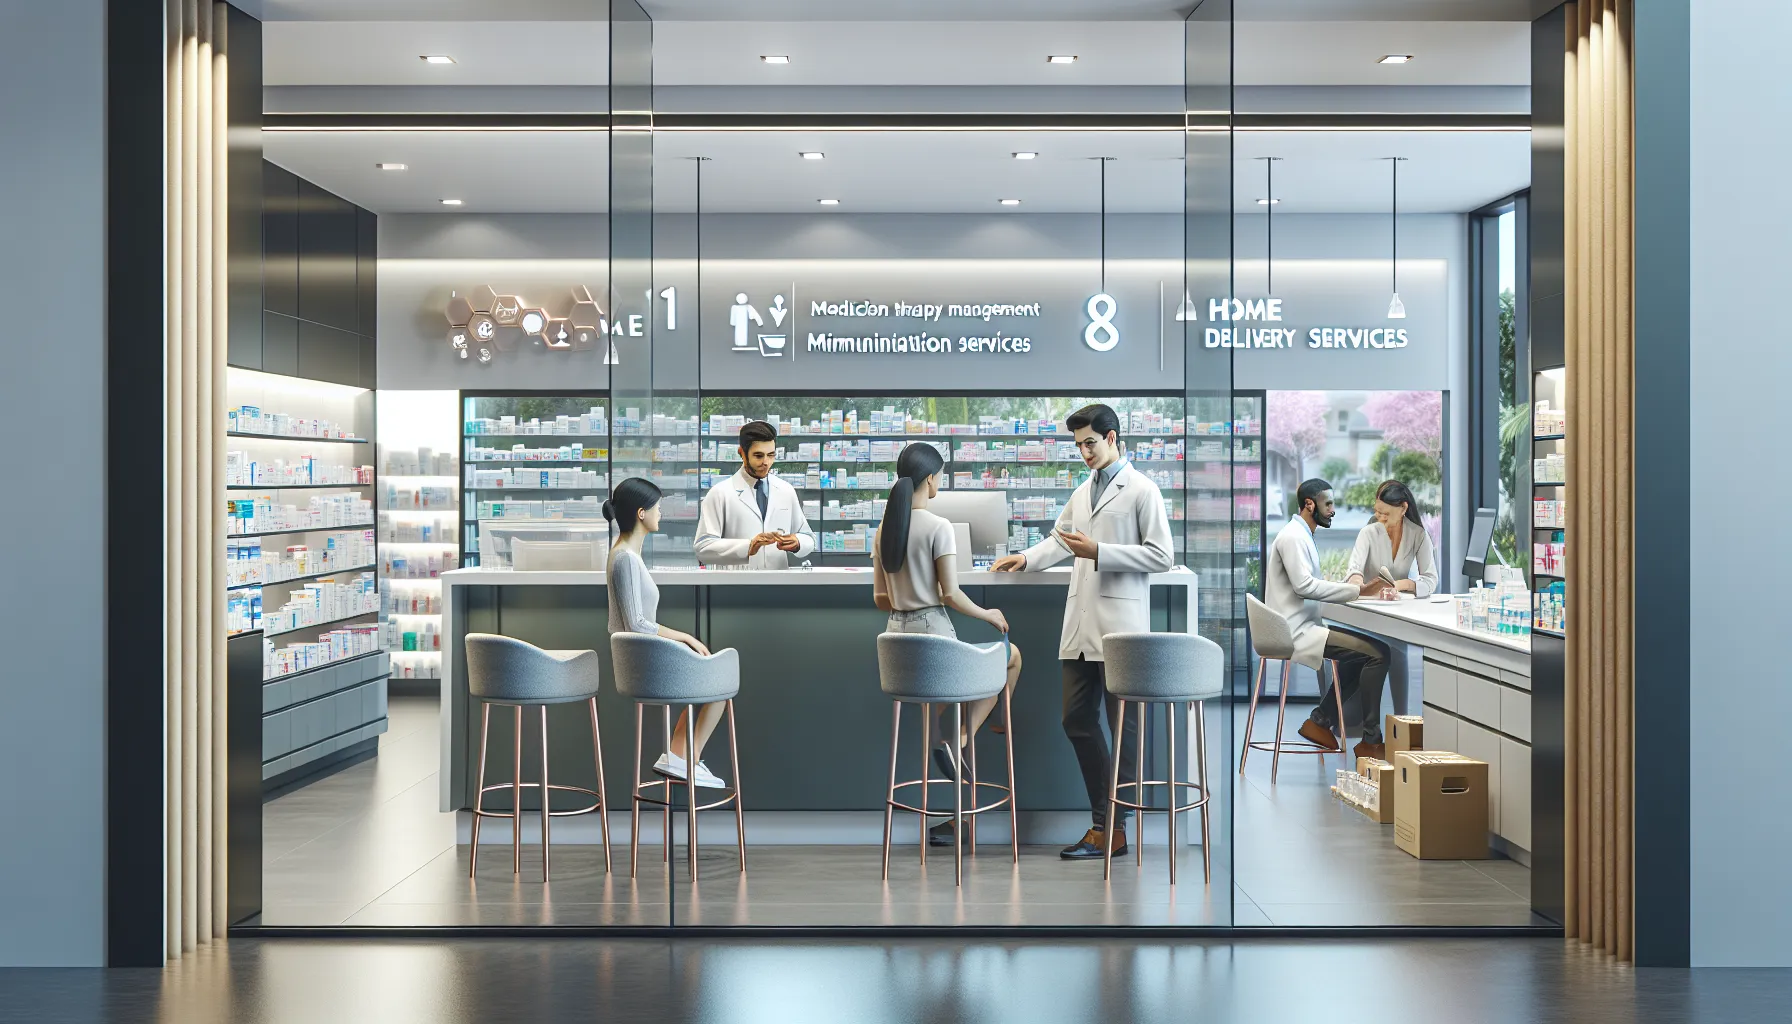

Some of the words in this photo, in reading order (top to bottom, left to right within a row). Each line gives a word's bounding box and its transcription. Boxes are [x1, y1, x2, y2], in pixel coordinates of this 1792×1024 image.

[1084, 293, 1120, 352] 8
[958, 330, 1031, 353] services
[1204, 327, 1297, 349] DELIVERY
[1308, 327, 1409, 349] SERVICES
